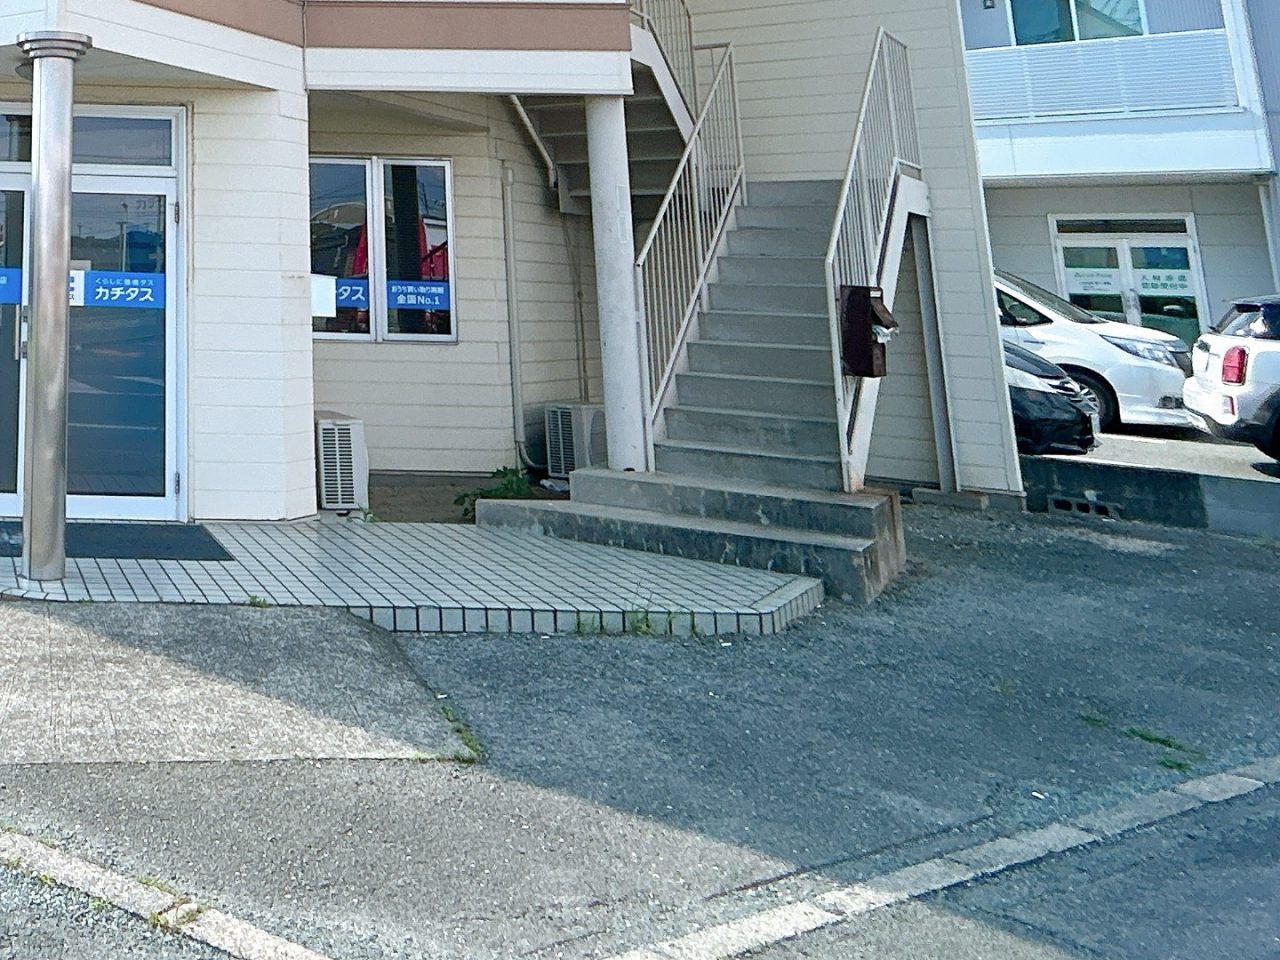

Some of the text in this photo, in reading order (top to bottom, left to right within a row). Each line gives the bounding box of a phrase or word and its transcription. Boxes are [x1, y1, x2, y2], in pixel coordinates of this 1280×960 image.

[95, 286, 155, 302] カチタス
[336, 286, 366, 301] タス
[396, 294, 440, 305] 全国No.1
